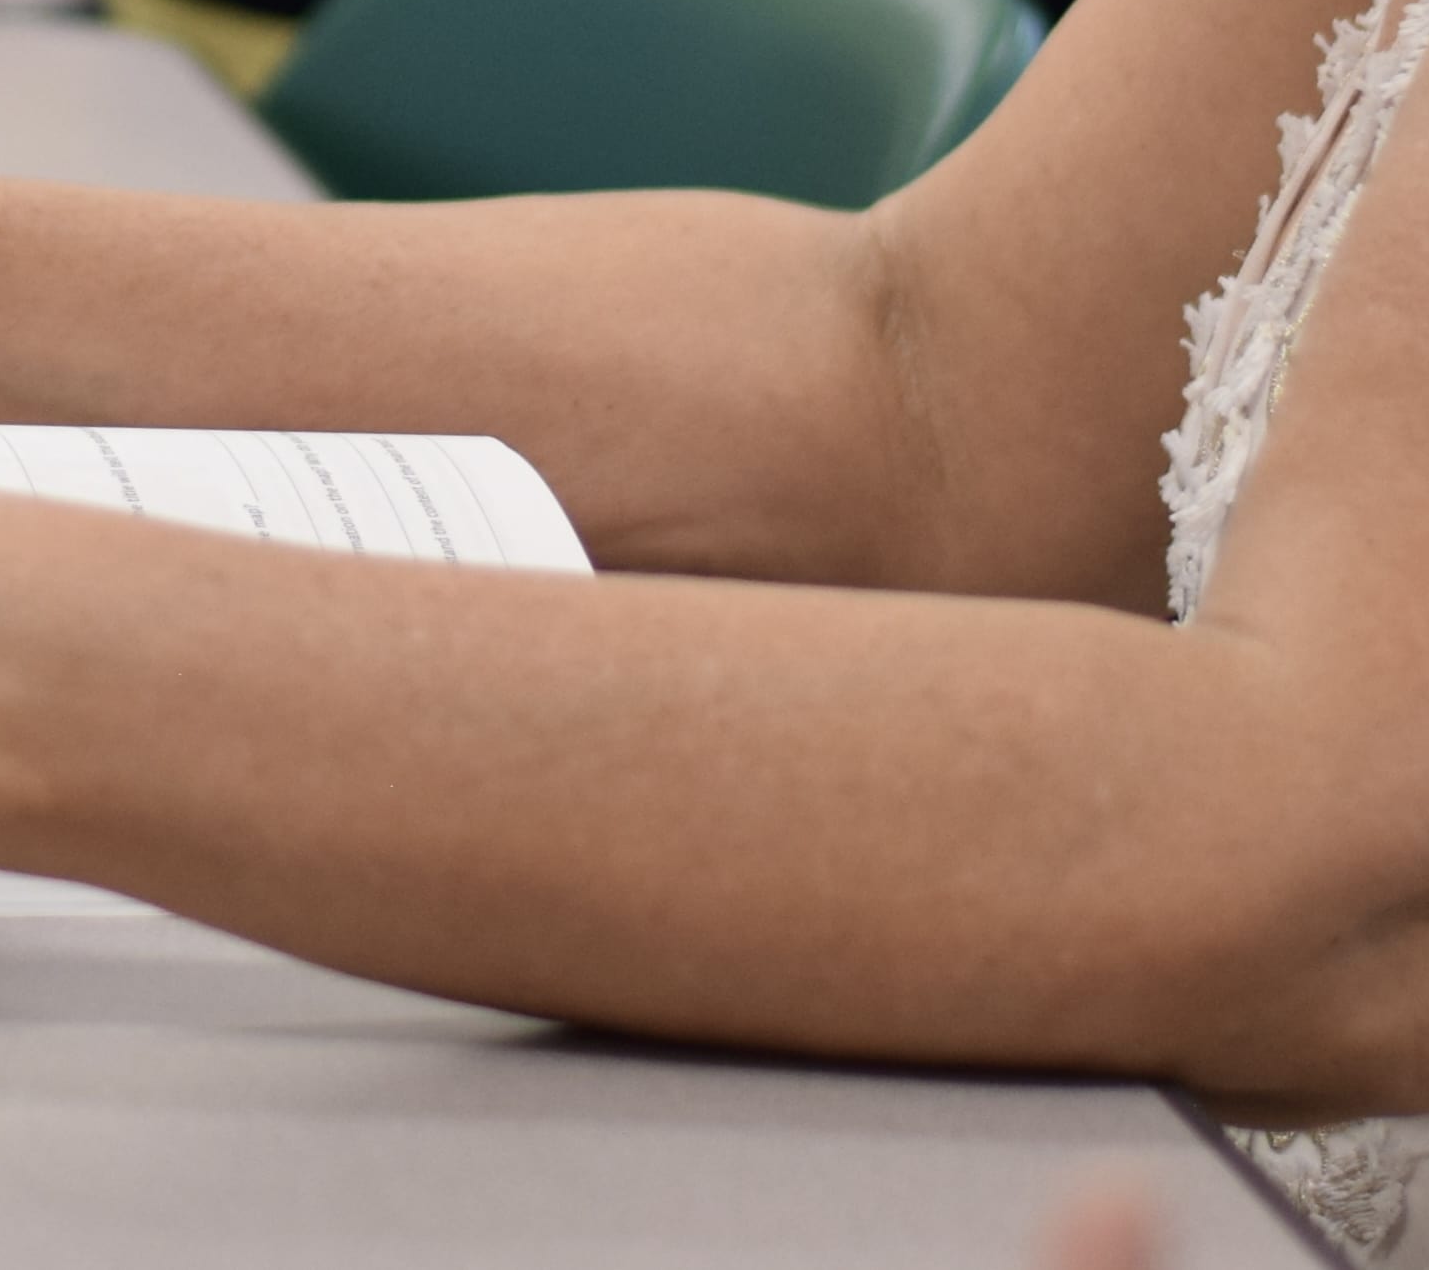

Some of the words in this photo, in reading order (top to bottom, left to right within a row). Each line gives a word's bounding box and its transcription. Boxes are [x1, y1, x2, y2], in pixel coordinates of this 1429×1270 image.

[398, 465, 416, 476] the
[404, 476, 423, 486] of
[120, 486, 140, 502] title
[325, 488, 344, 502] the
[333, 503, 350, 515] on
[411, 487, 440, 519] content
[428, 520, 448, 536] the
